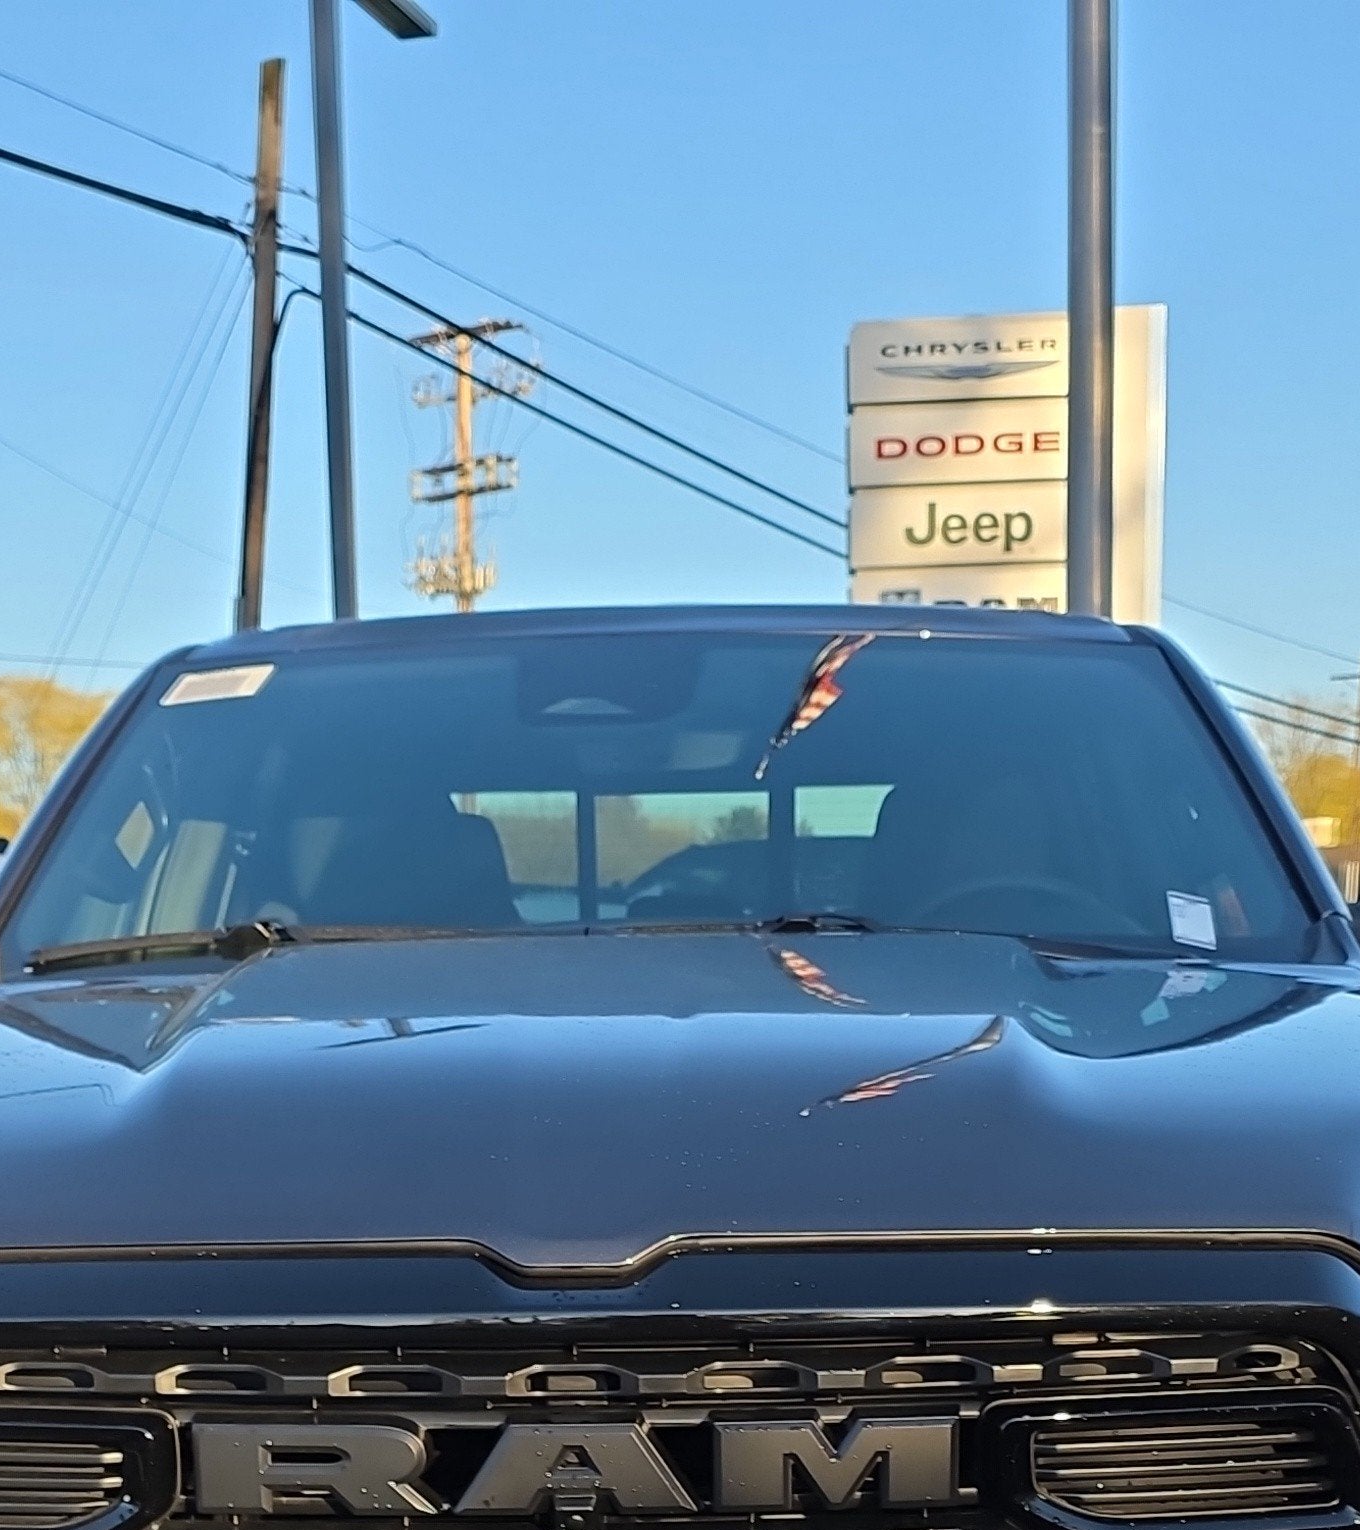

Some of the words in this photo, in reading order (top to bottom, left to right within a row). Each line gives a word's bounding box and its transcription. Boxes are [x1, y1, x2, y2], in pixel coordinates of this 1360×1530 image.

[880, 338, 1058, 358] CHRYSLER
[876, 431, 1061, 459] DODGE
[905, 502, 1033, 552] Jeep
[192, 1415, 961, 1515] RAM
